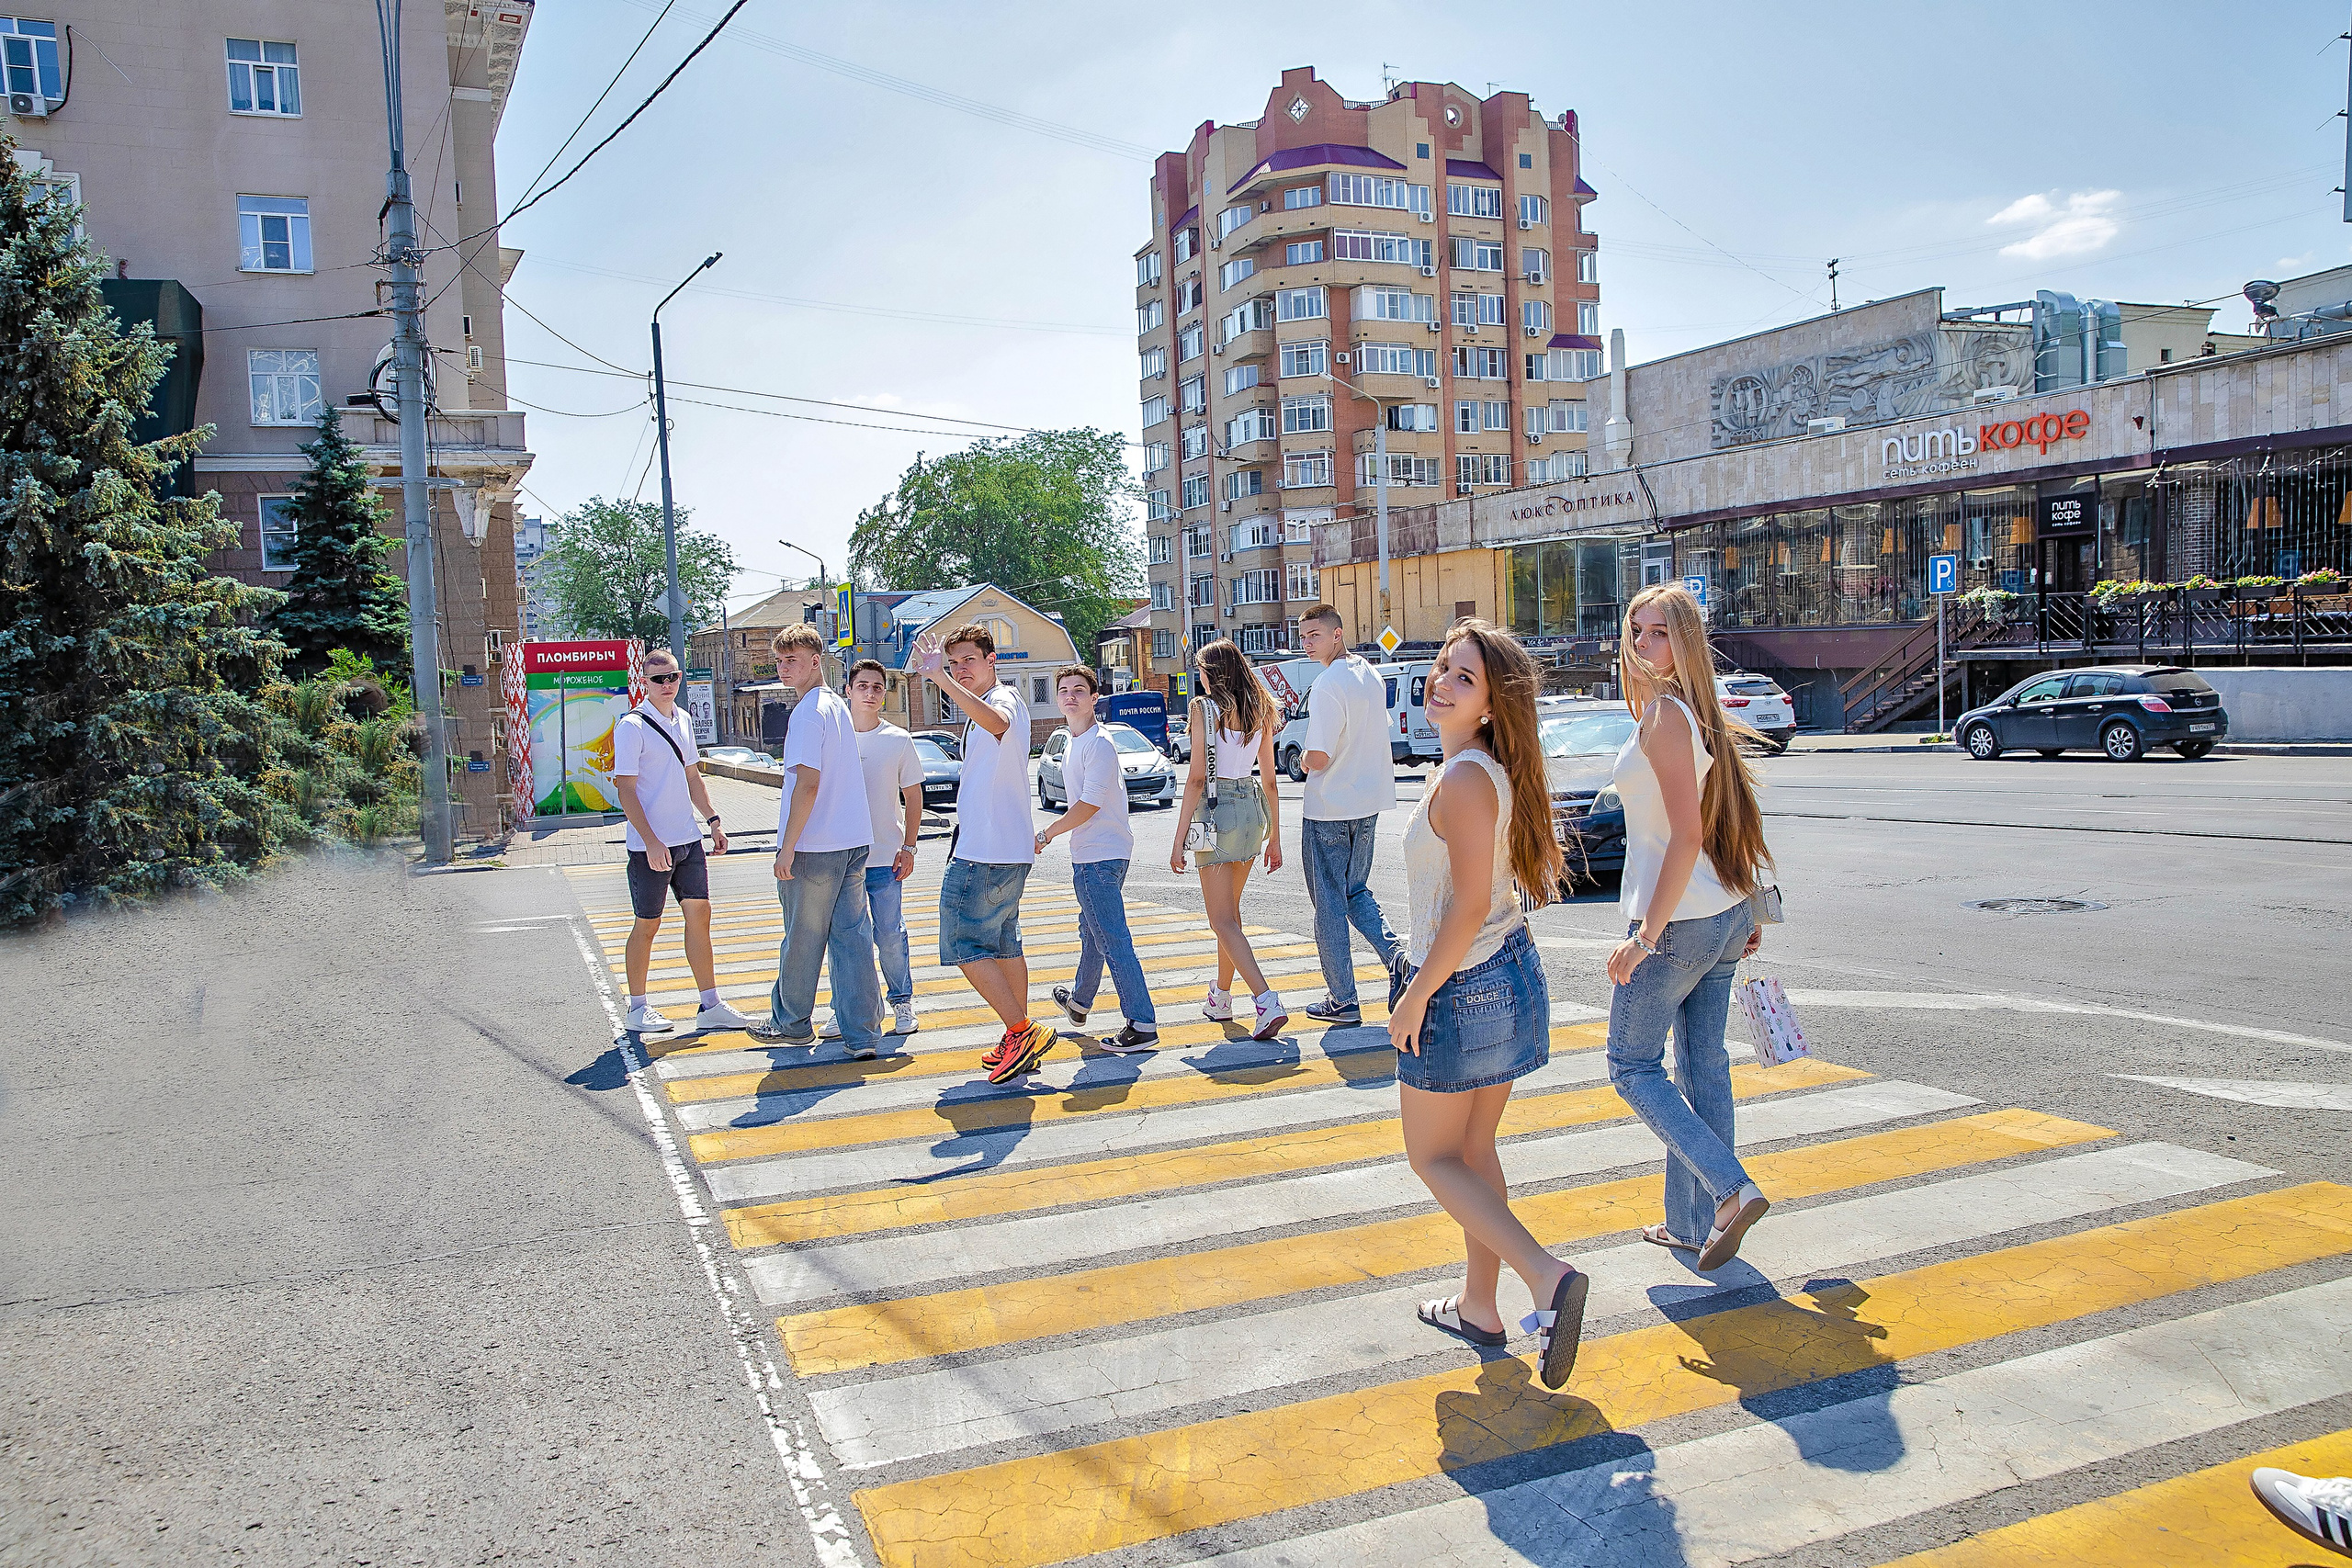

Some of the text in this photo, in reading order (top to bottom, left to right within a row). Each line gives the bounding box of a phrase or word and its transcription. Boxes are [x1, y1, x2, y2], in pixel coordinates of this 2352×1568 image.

[1883, 458, 1979, 479] сеть кофеен
[1510, 491, 1635, 521] ЛЮКС ОПТИКА
[1937, 559, 1951, 589] P
[537, 650, 616, 663] ПЛОМБИРЫЧ
[1139, 706, 1161, 715] РОССИИ
[1466, 991, 1499, 1003] DOLCE
